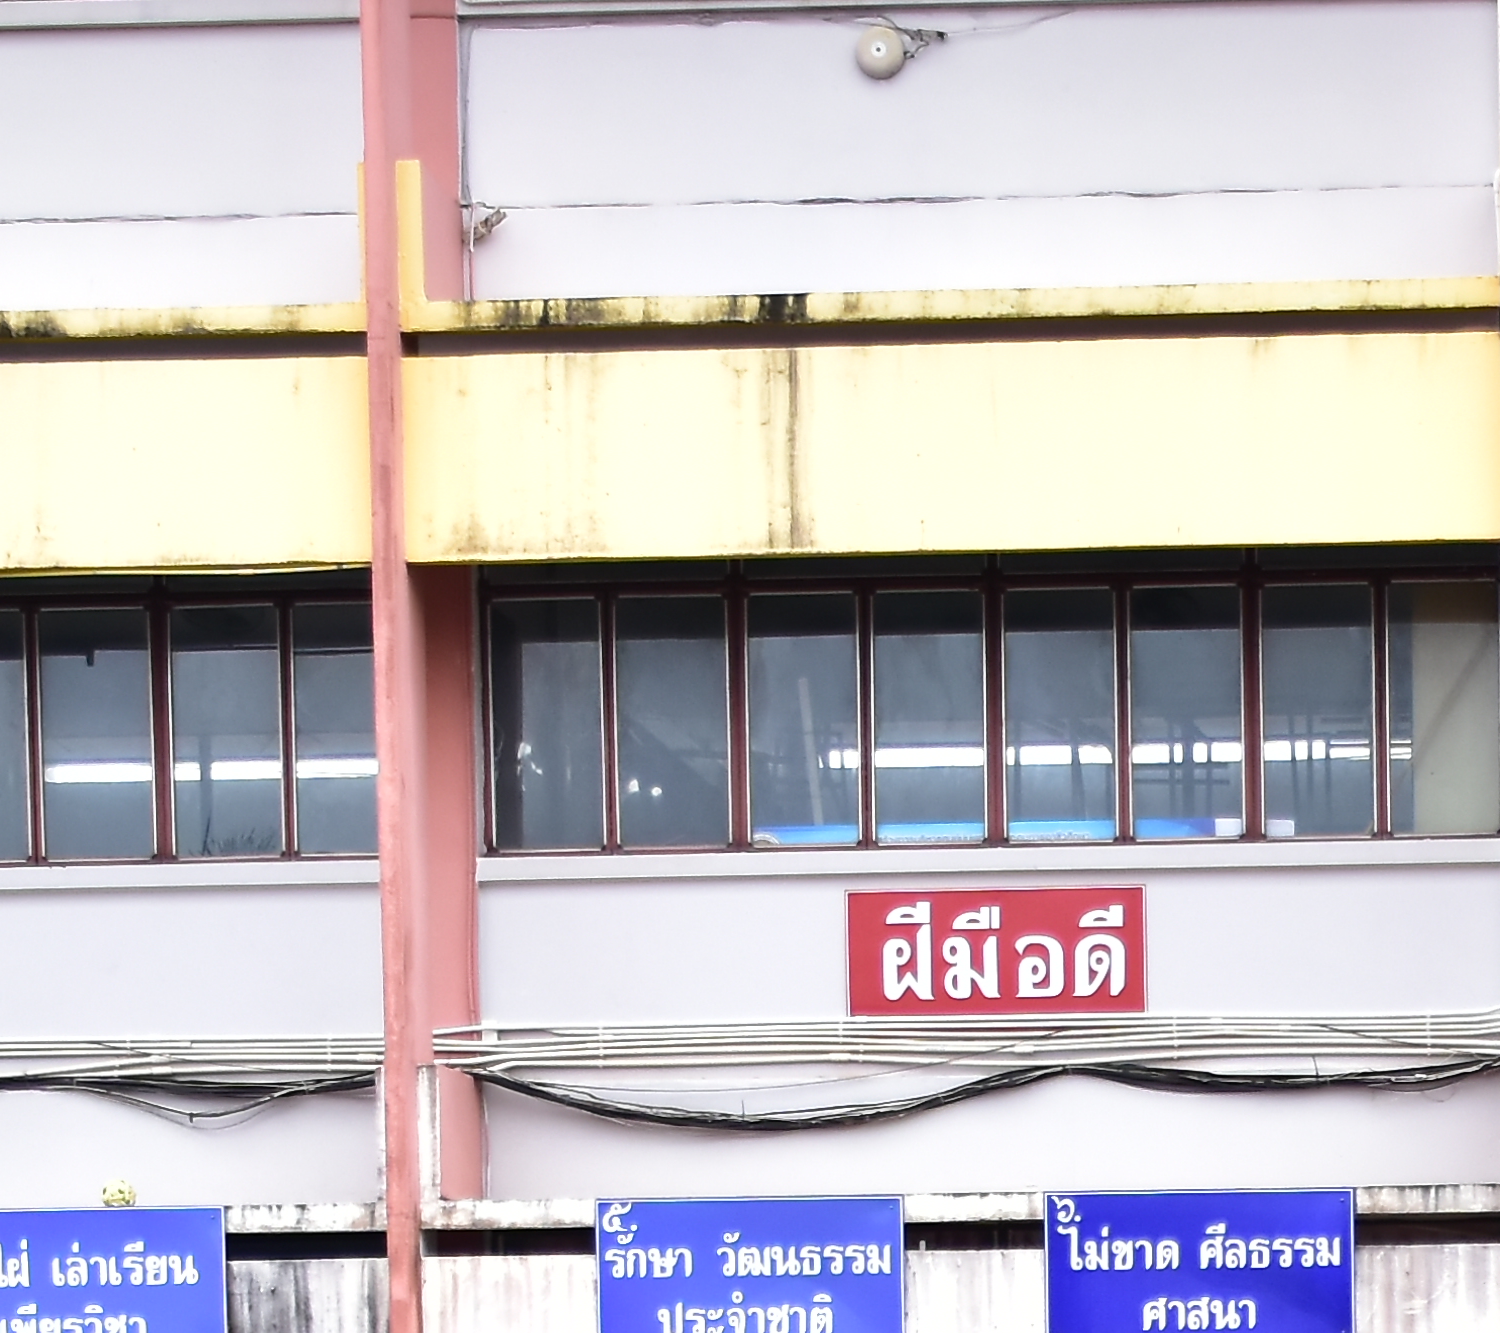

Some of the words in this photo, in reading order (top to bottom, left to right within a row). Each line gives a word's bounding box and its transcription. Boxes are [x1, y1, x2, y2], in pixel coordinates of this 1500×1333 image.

[883, 901, 1125, 1000] ฝีมือดี
[50, 1240, 199, 1286] เล่าเรียน
[605, 1233, 692, 1278] รักษา
[717, 1232, 891, 1276] วัฒนธรรม
[1061, 1225, 1179, 1270] ไม่ขาด
[1200, 1223, 1340, 1269] ศีลธรรม
[1143, 1297, 1256, 1330] ศาสนา
